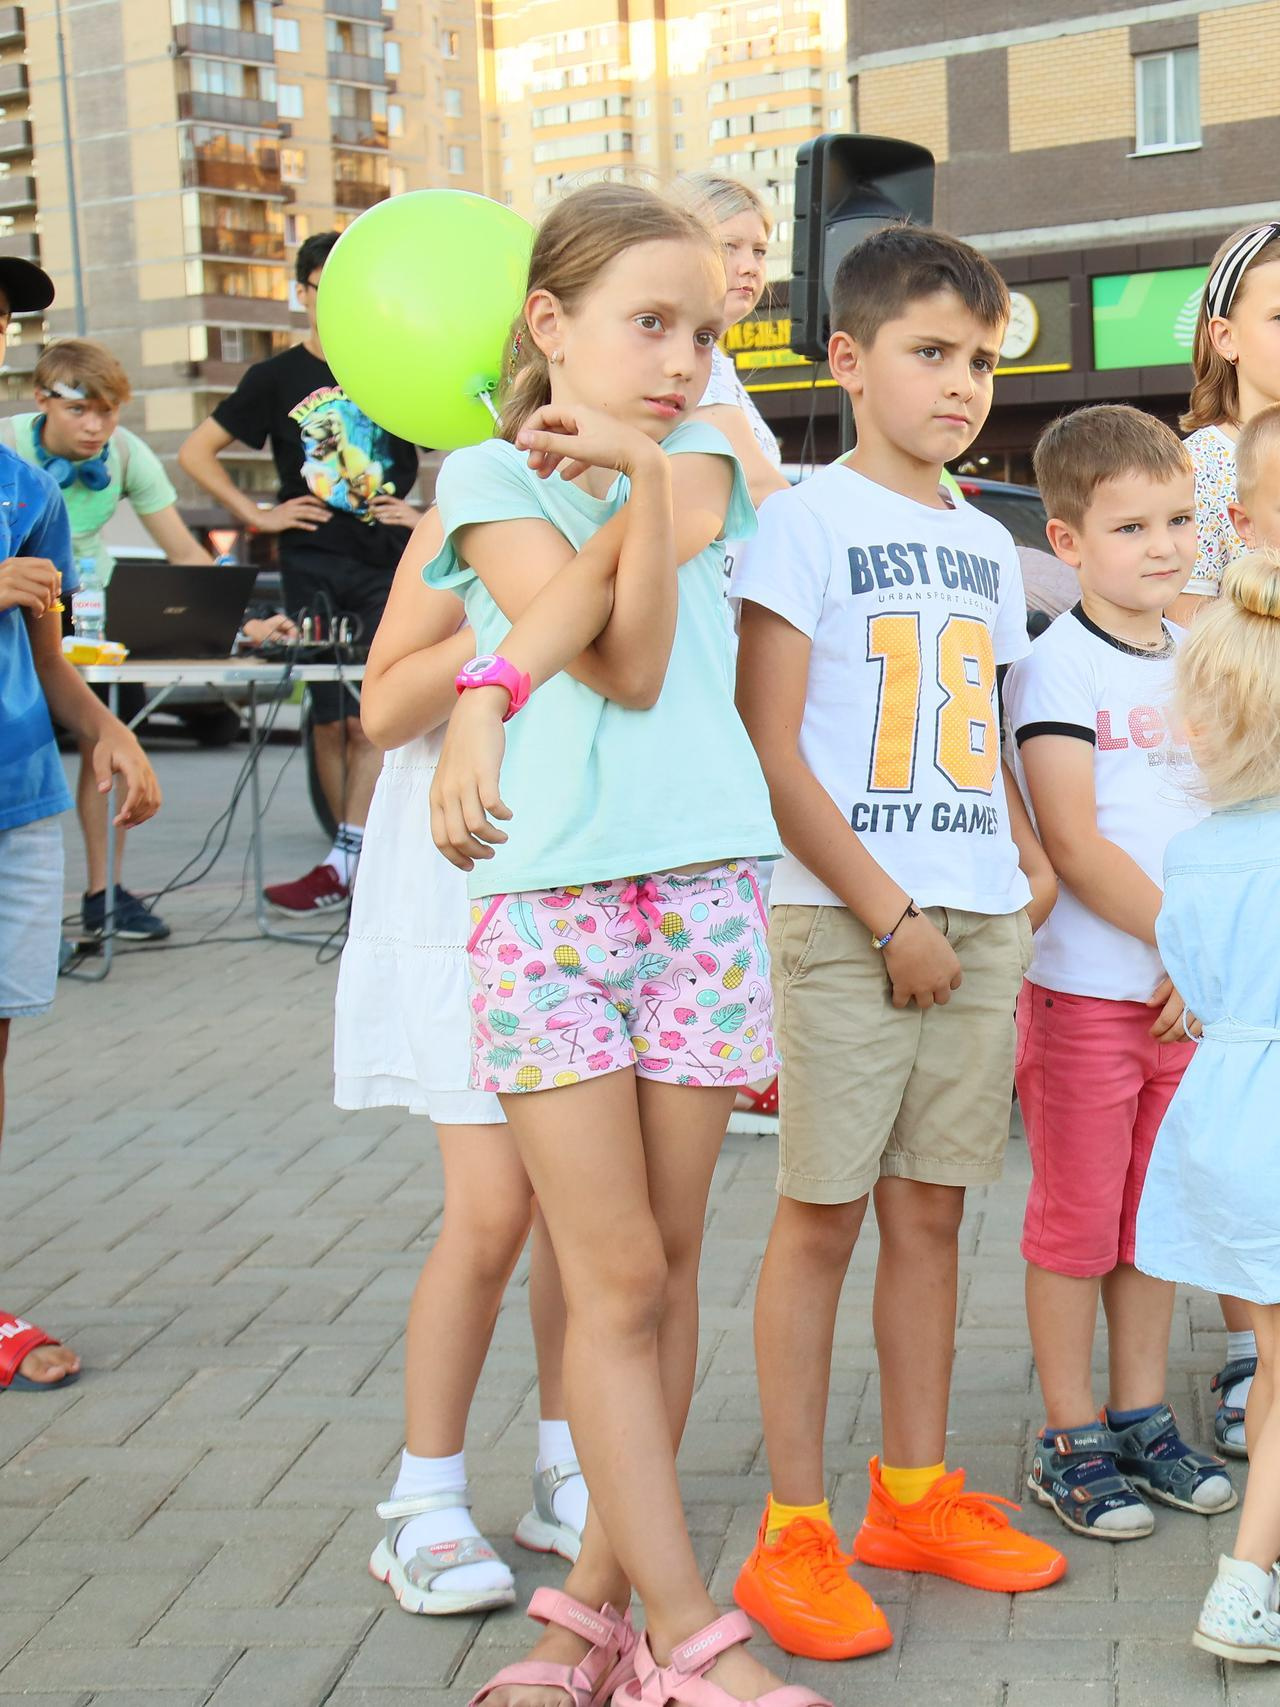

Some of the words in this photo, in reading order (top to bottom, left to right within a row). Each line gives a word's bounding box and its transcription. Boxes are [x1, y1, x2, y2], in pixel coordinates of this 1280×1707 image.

[847, 542, 931, 596] BEST
[878, 591, 922, 603] URBAN
[926, 591, 960, 603] SPORT
[866, 611, 999, 796] 18
[851, 802, 922, 833] CITY
[931, 801, 999, 835] GAMES
